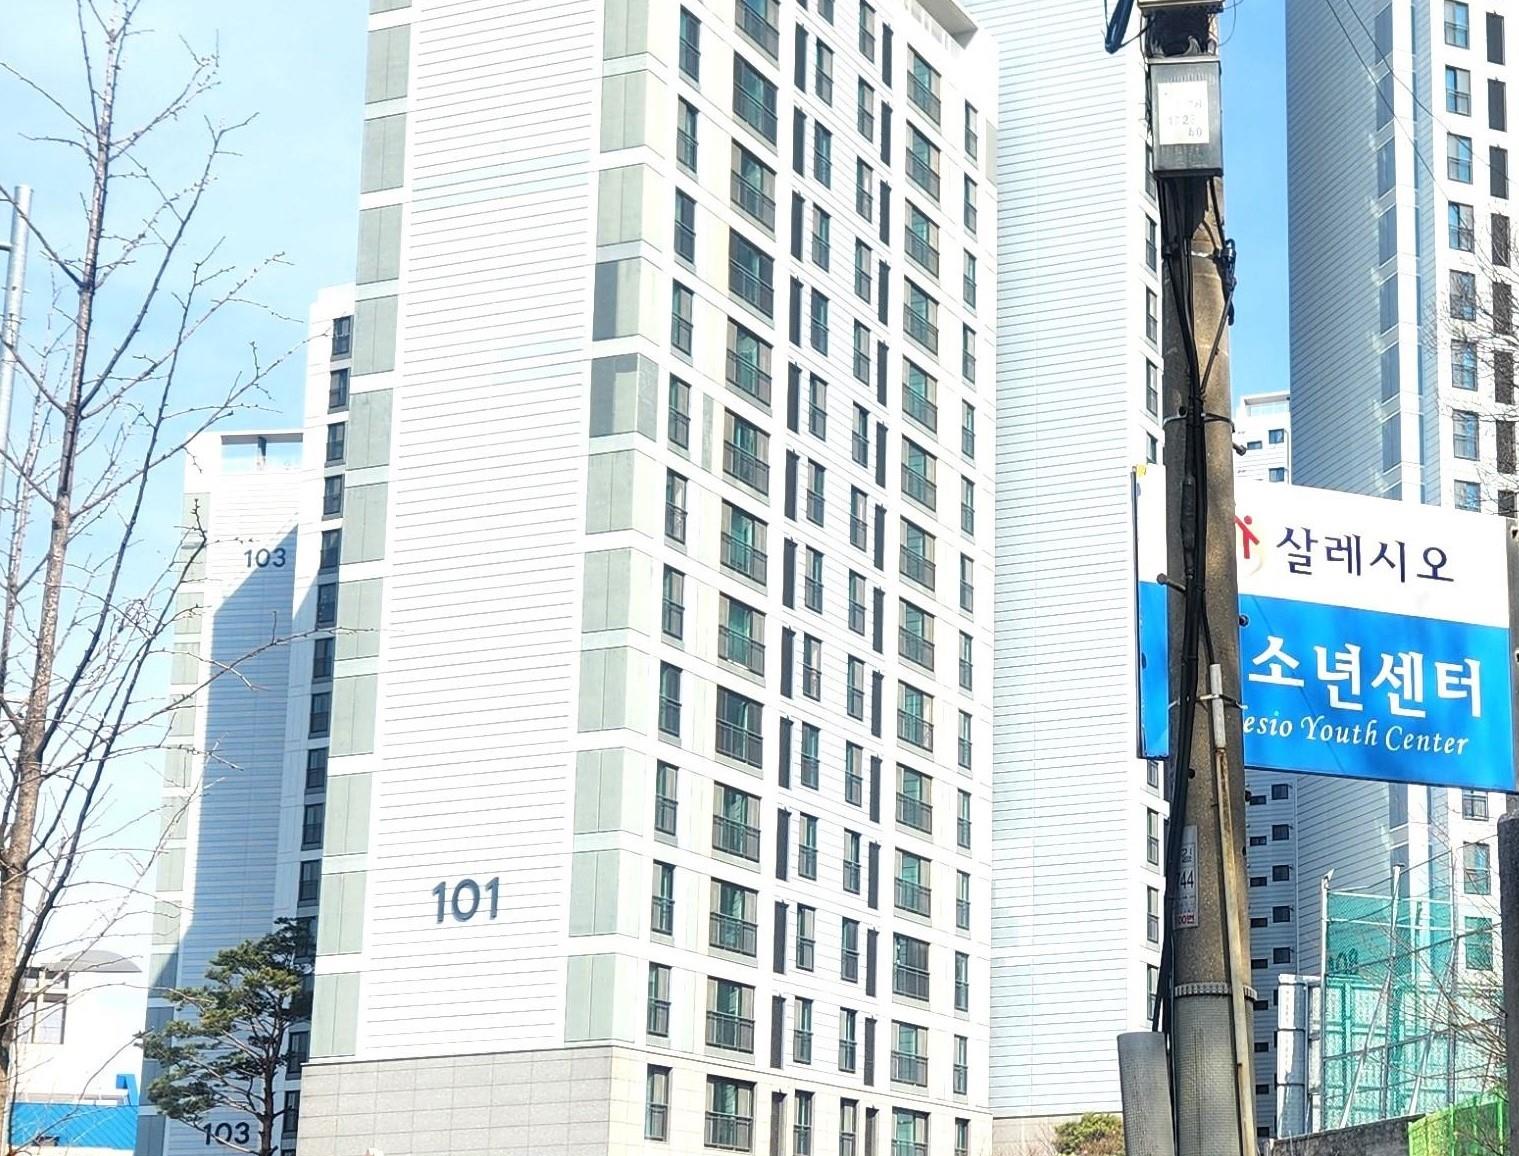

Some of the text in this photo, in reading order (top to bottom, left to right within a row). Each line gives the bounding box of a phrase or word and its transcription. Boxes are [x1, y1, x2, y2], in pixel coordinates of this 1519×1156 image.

[243, 547, 287, 569] 103
[1276, 526, 1455, 583] 살레시오
[1248, 635, 1482, 718] 소년센터
[1243, 710, 1469, 756] esio Youth Center
[431, 876, 500, 925] 101
[203, 1121, 250, 1146] 103
